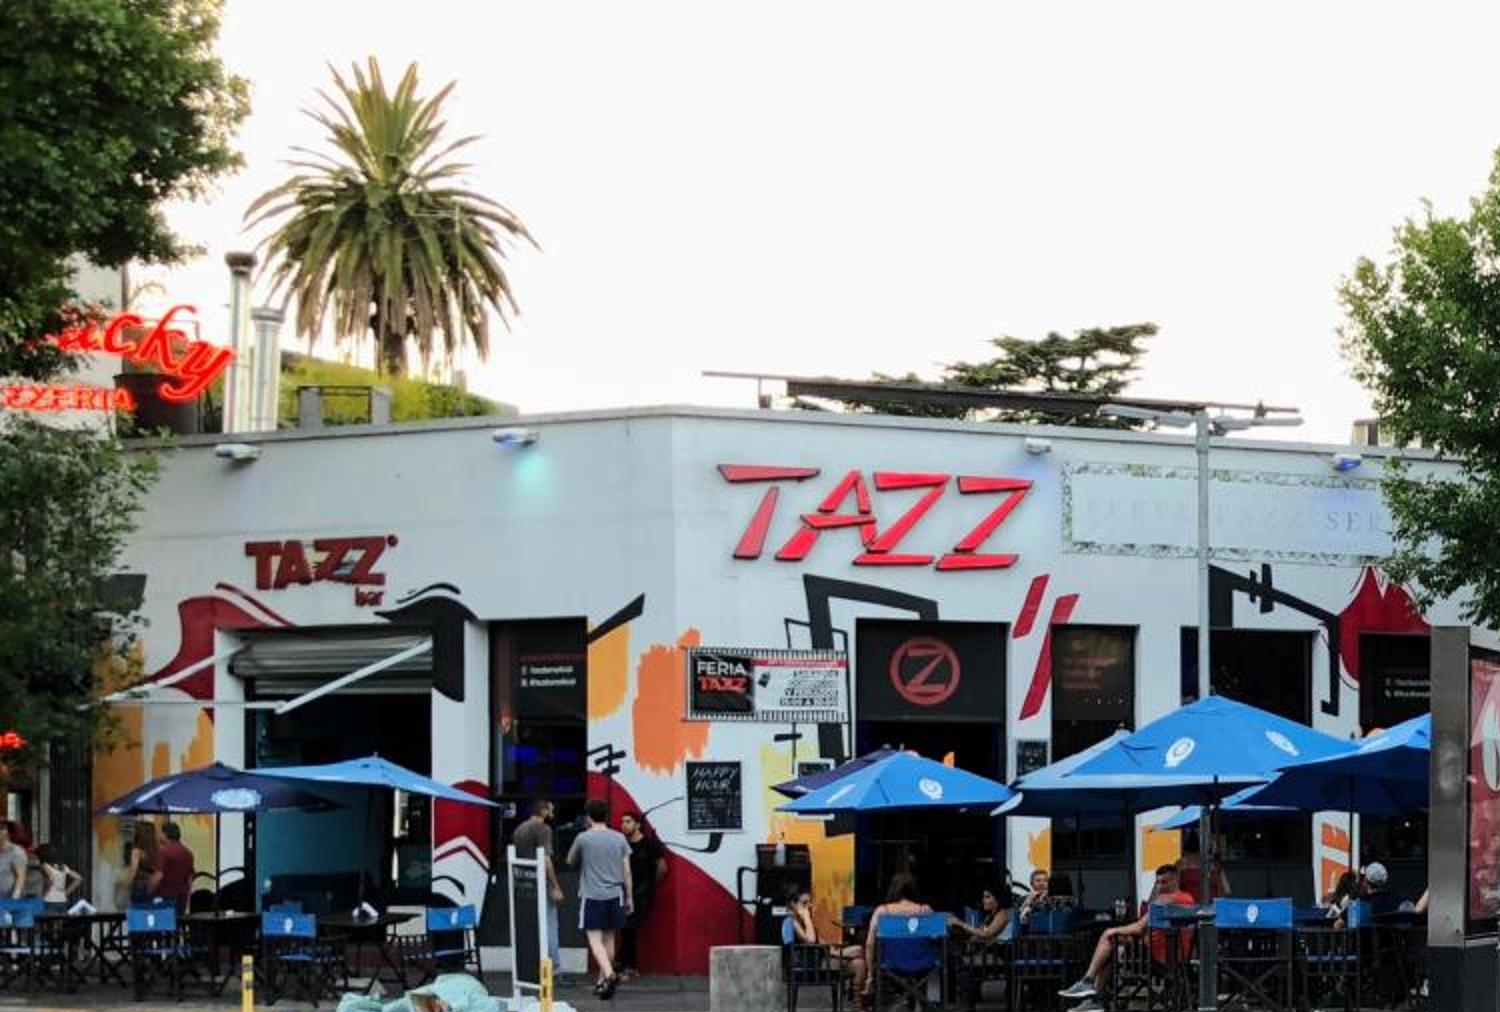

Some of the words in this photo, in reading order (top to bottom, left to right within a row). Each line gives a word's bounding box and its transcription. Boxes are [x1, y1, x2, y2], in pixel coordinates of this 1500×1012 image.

[717, 464, 1034, 571] TAZZ
[244, 536, 386, 591] TAZZ
[696, 660, 748, 676] FERIA
